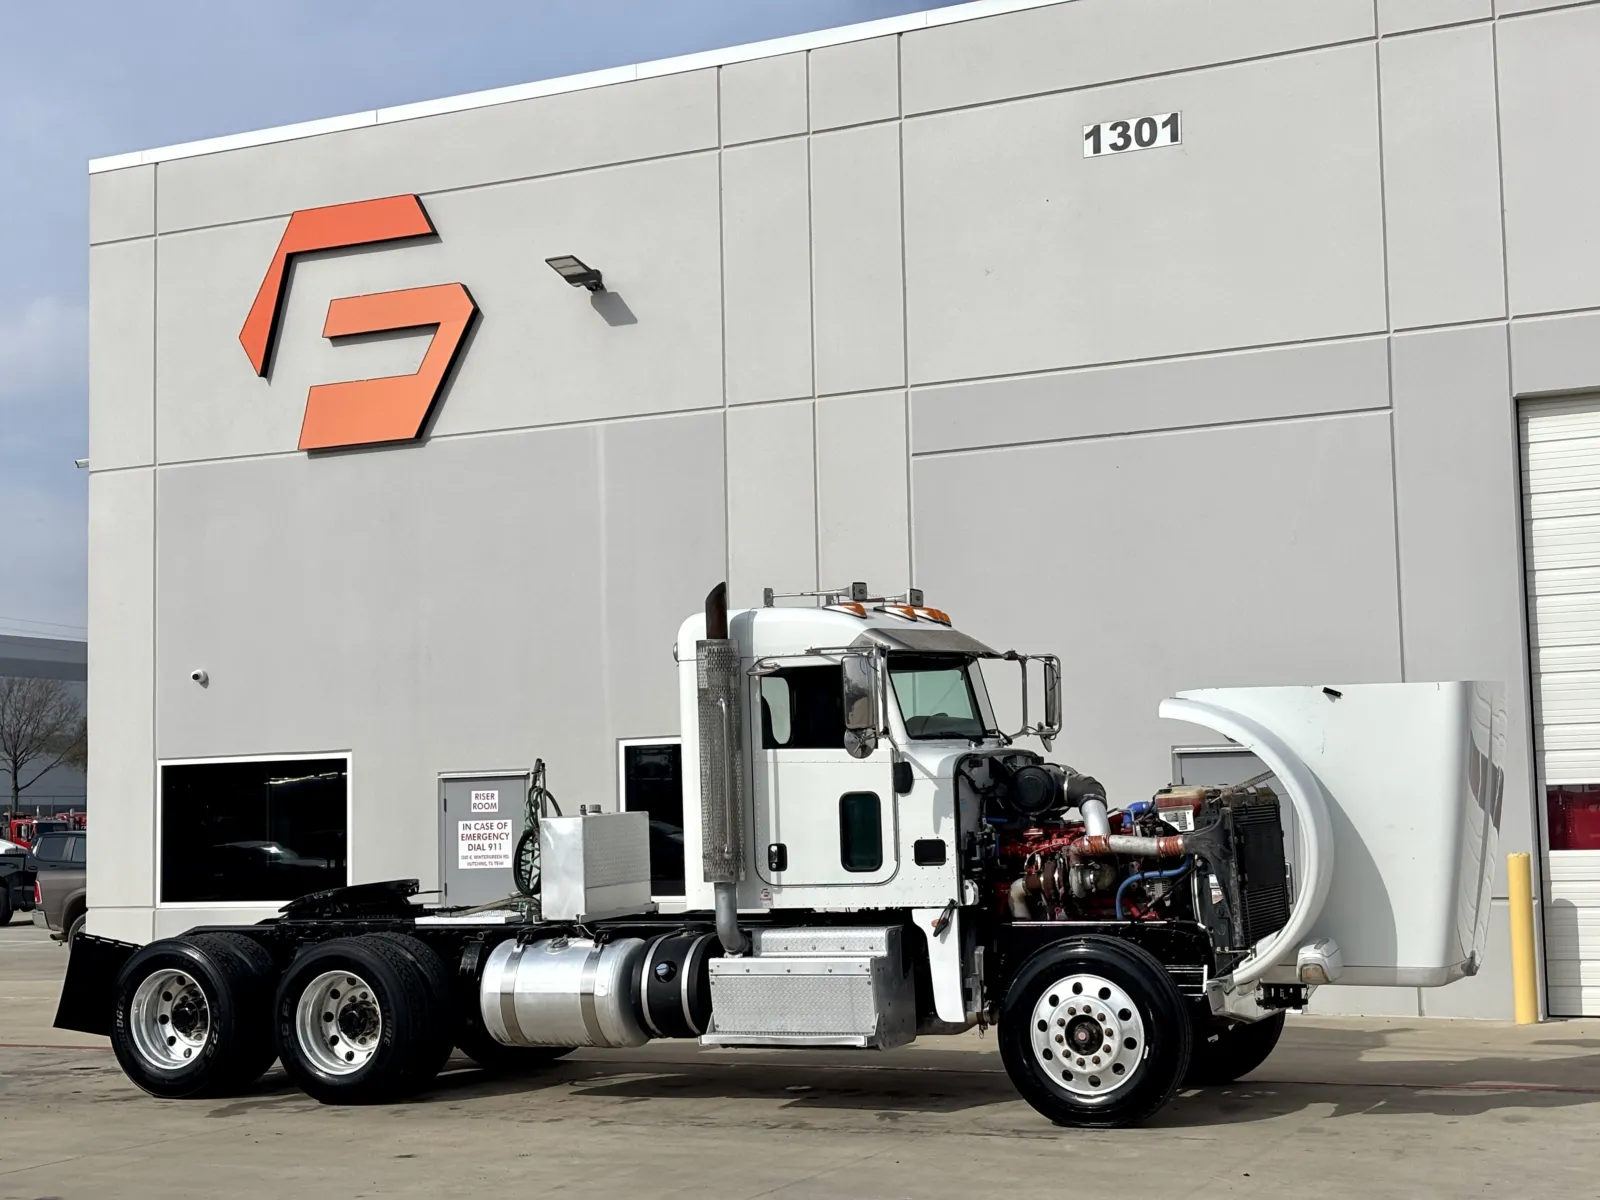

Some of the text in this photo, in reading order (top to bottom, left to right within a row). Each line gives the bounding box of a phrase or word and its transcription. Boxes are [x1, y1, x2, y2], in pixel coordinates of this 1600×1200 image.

[1085, 112, 1179, 154] 1301
[473, 802, 497, 810] ROOM
[462, 822, 508, 831] IN CASE OF
[461, 832, 510, 841] EMERGENCY
[468, 843, 502, 851] DIAL 911
